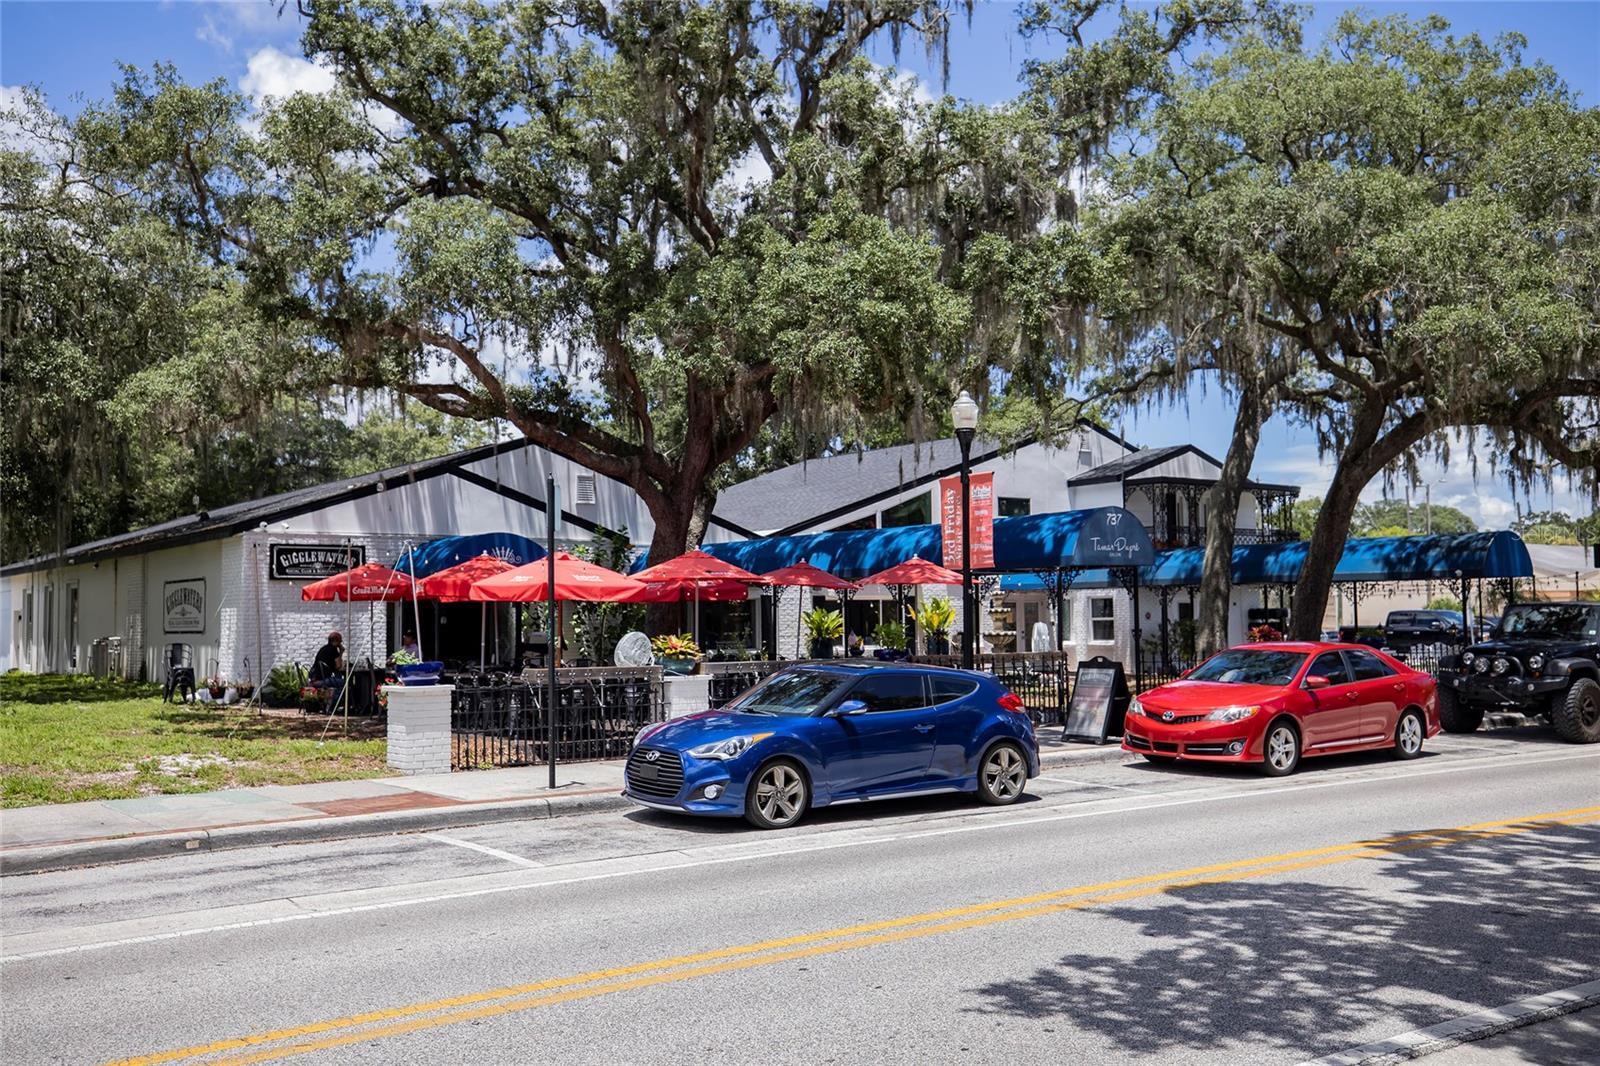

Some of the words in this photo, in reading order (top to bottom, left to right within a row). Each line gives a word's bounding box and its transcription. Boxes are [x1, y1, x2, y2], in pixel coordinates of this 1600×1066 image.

[944, 488, 956, 534] Friday
[1106, 513, 1122, 526] 737
[943, 540, 956, 564] 3rd
[1090, 537, 1115, 551] Tamar
[280, 551, 357, 568] GIGGLEWATERS
